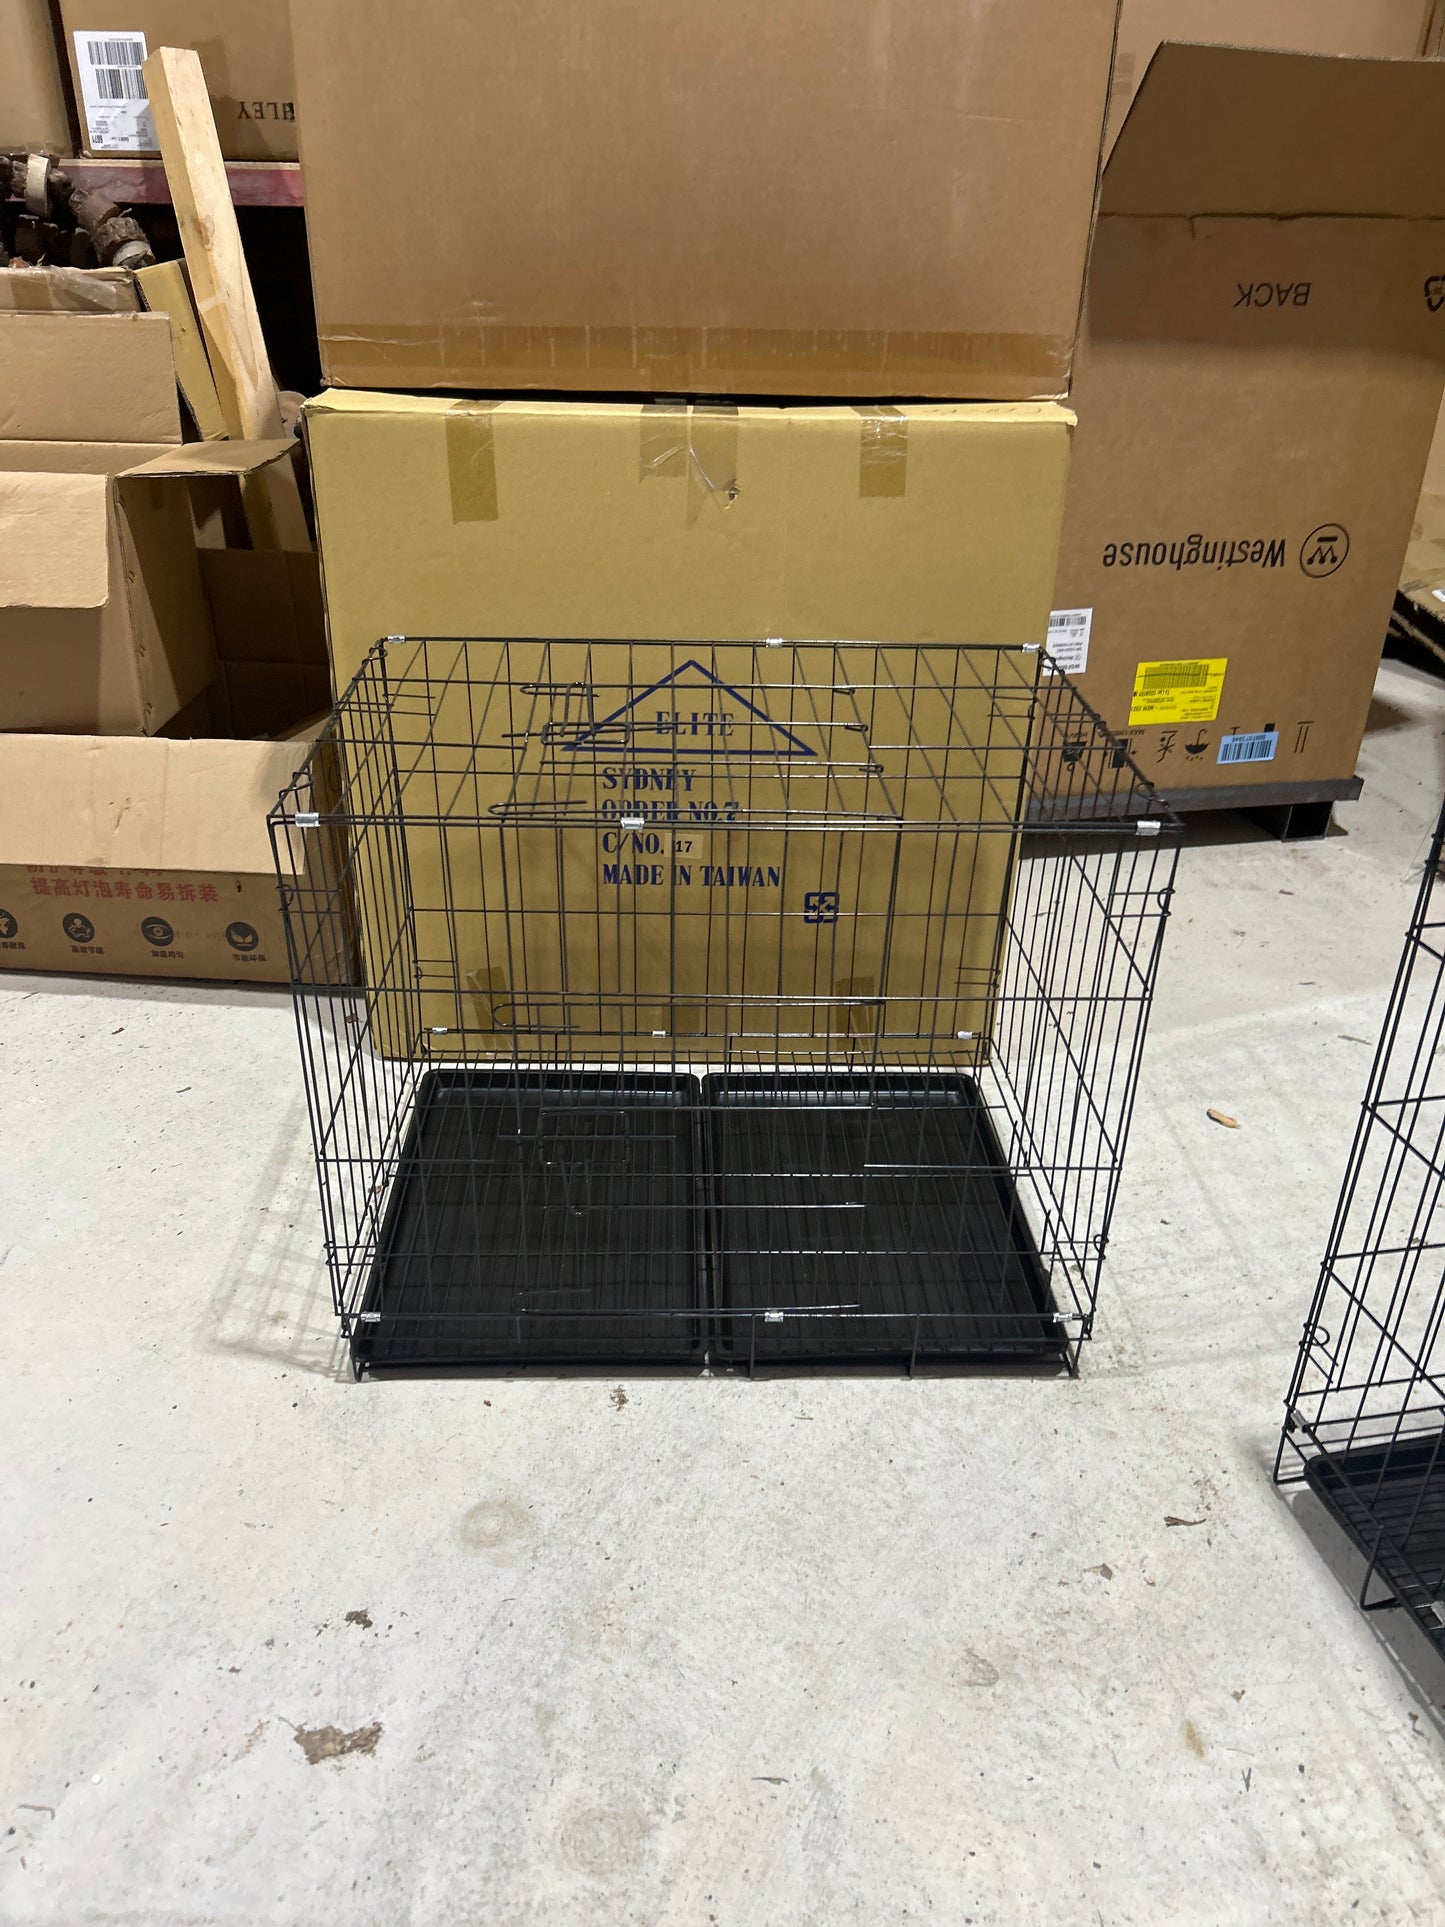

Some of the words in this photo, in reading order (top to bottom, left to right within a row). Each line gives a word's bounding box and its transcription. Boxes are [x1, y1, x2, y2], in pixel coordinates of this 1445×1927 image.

[1234, 282, 1313, 309] BACK
[1103, 533, 1287, 571] Westinghouse
[656, 711, 734, 736] ELITE
[602, 767, 696, 792] SYDNEY
[602, 799, 680, 822] ORDER
[602, 832, 665, 855] C/NO.
[603, 864, 664, 886] MADE
[674, 865, 692, 886] IN
[699, 865, 781, 887] TAIWAN
[30, 876, 219, 903] 提高灯泡寿命易拆装
